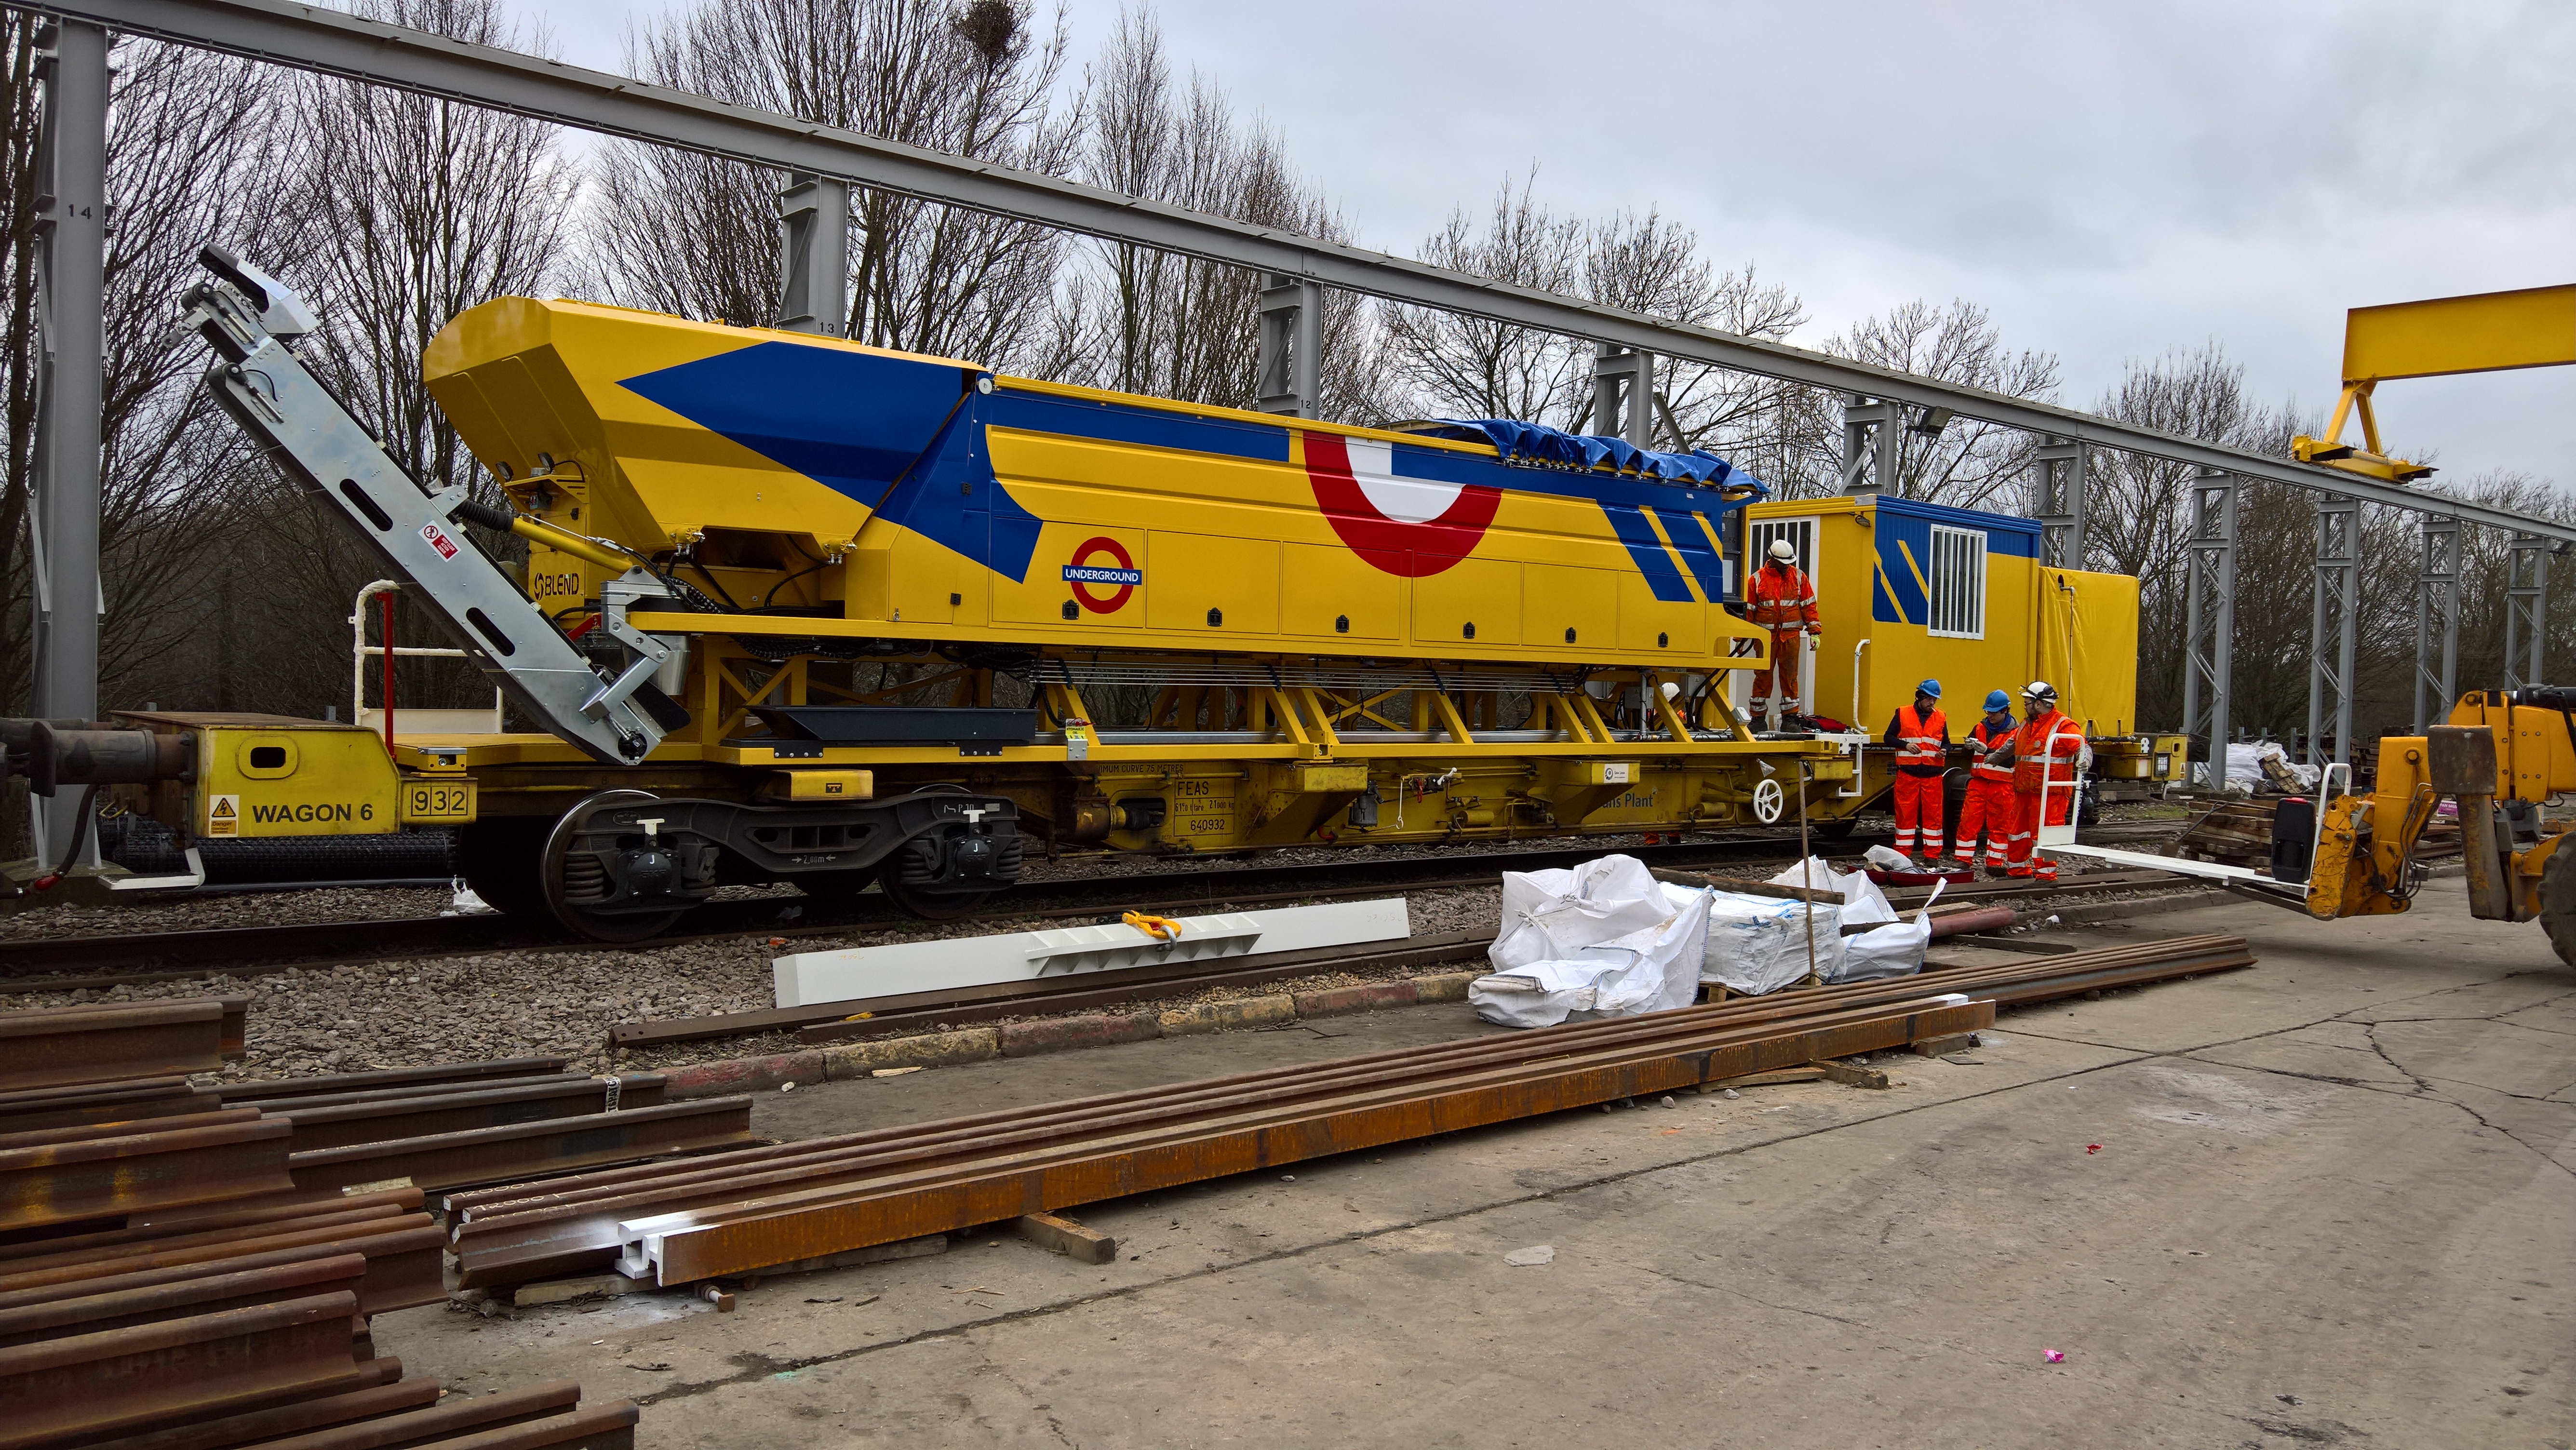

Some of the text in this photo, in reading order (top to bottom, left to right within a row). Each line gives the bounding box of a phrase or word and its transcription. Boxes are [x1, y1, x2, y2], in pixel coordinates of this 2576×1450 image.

[68, 204, 92, 220] 14
[819, 321, 834, 334] 13
[1300, 399, 1311, 409] 12
[1066, 568, 1139, 582] UNDERGROUND
[544, 573, 579, 596] BLEND
[1122, 765, 1143, 773] CURVE
[1157, 764, 1184, 773] METRES
[1177, 781, 1209, 796] FEAS
[414, 791, 466, 811] 932
[1228, 801, 1234, 810] kg
[1625, 792, 1653, 807] Plant
[252, 803, 374, 823] WAGON 6
[1190, 819, 1225, 831] 640932
[973, 843, 978, 852] J
[649, 855, 655, 864] J
